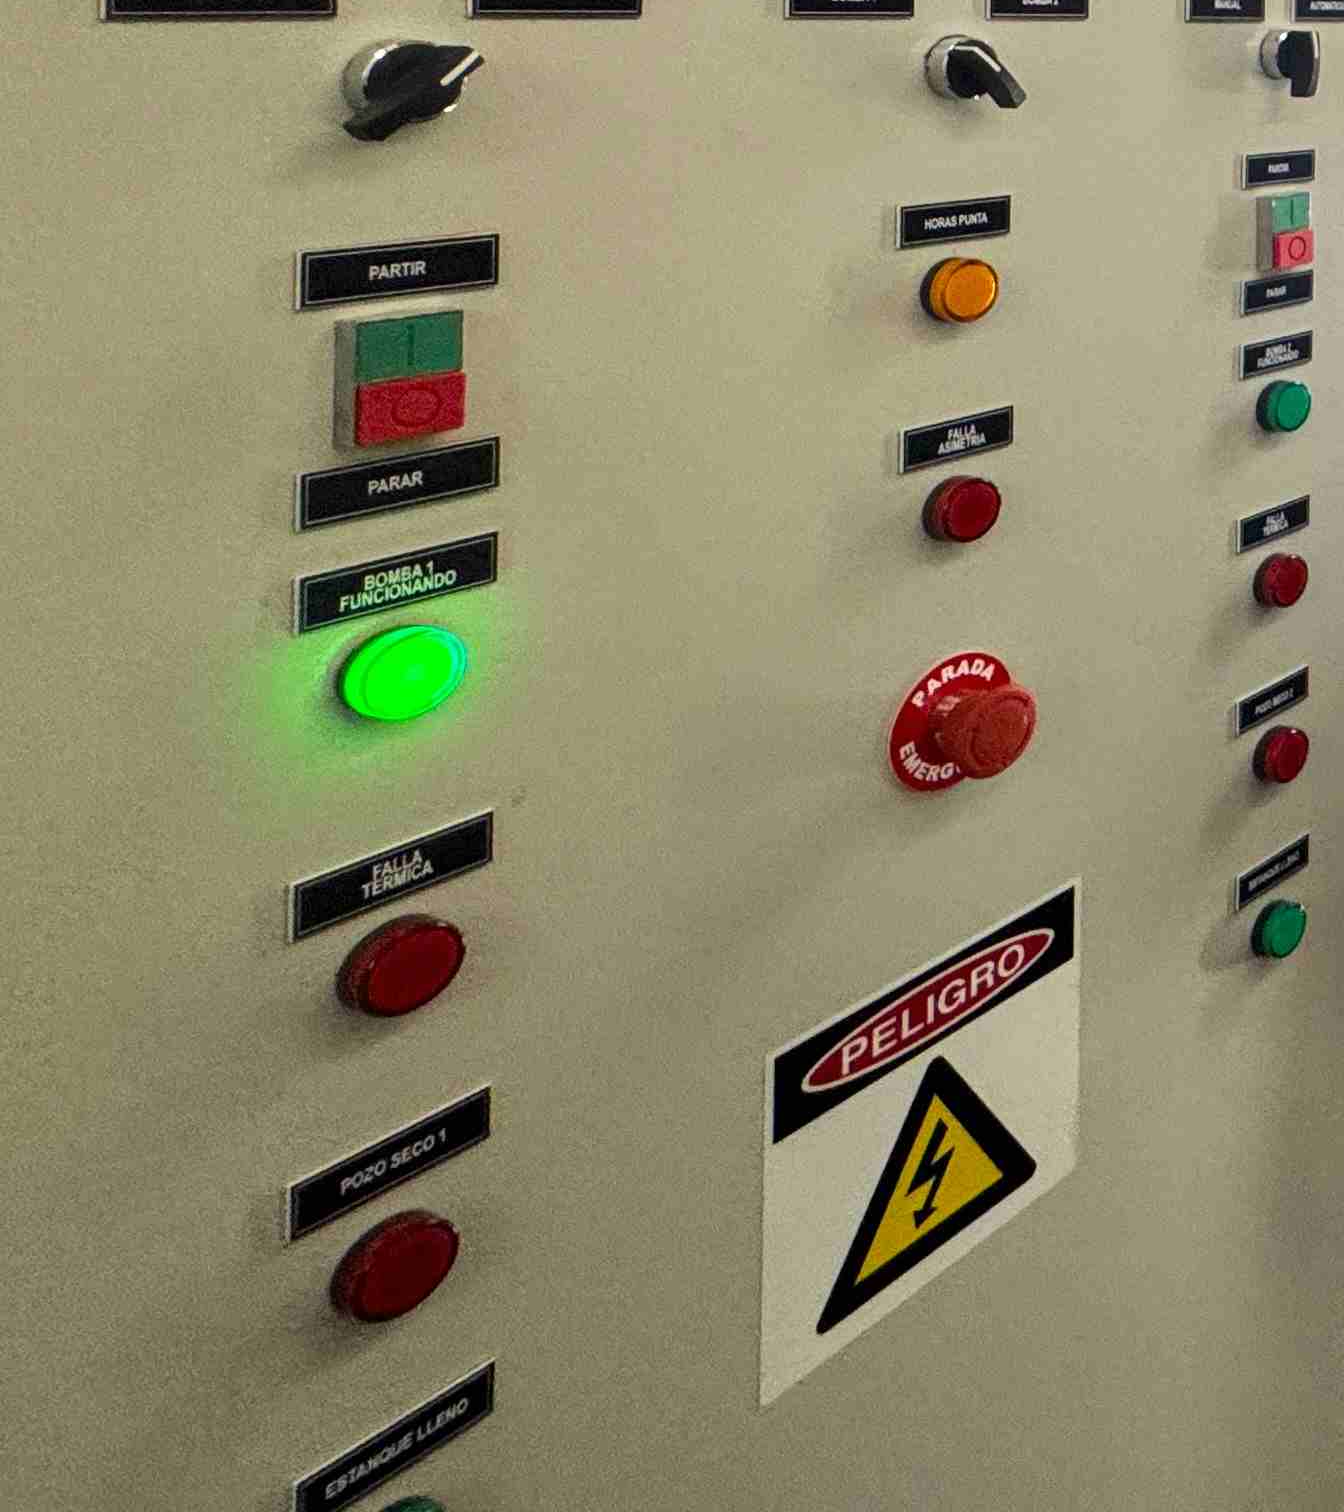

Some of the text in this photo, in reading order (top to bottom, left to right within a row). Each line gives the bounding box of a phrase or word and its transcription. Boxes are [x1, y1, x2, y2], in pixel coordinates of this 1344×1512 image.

[924, 211, 989, 232] HORAS PUNTA
[368, 259, 427, 281] PARTIR
[936, 432, 987, 455] ASIMETRIA
[947, 423, 976, 441] FALLA
[367, 470, 424, 496] PARAR
[364, 559, 435, 590] BOMBA 1
[338, 570, 458, 613] FUNCIONANDO
[911, 658, 996, 708] PARADA
[371, 848, 423, 878] FALLA
[360, 859, 434, 900] TERMICA
[840, 943, 1026, 1076] PELIGRO
[339, 1128, 448, 1197] POZO SECO 1
[324, 1396, 469, 1500] ESTANQUE LLENO
